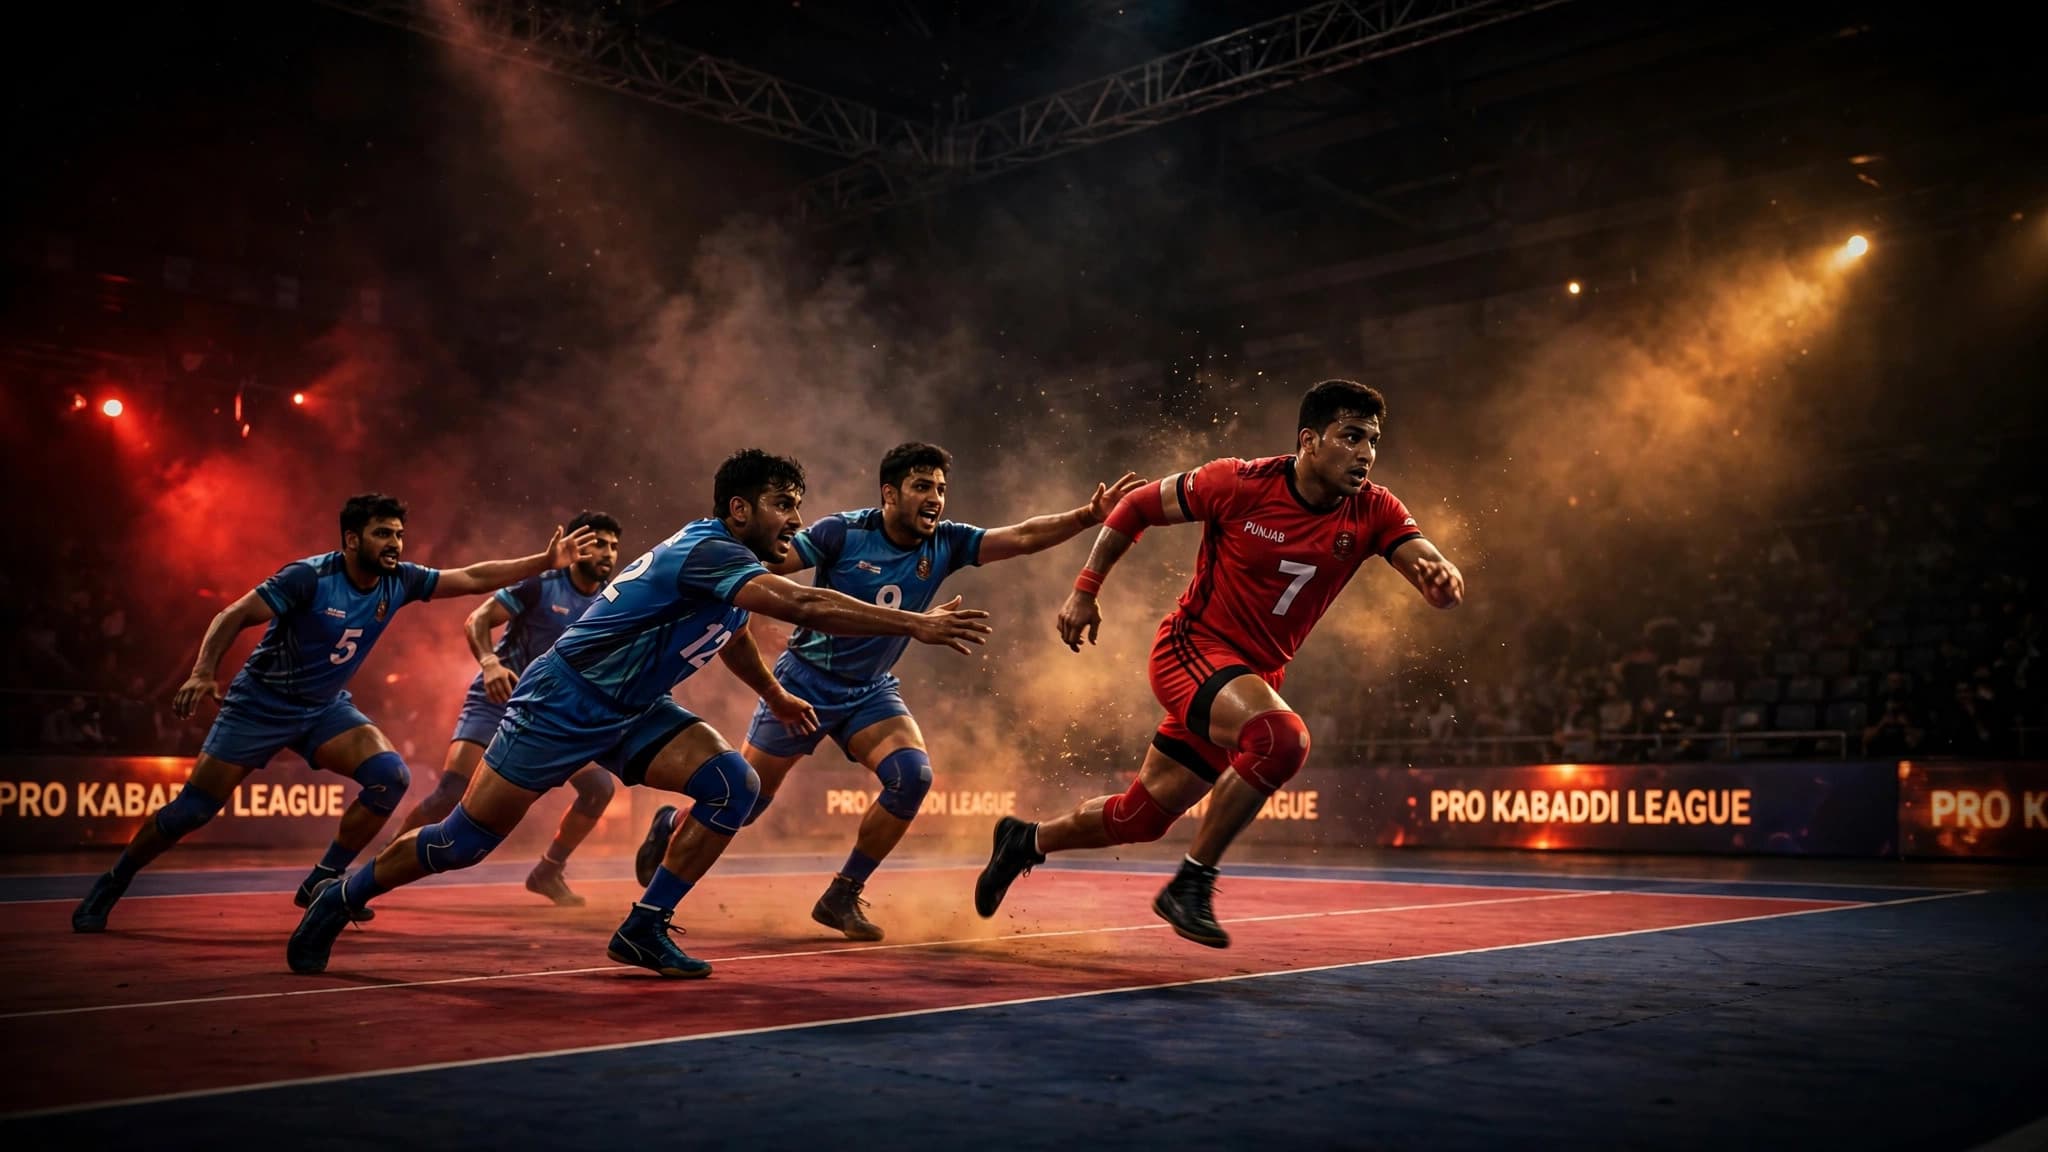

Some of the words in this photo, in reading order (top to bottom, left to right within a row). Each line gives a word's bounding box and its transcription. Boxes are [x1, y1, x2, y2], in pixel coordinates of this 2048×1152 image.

[1243, 520, 1286, 543] PUNJAB
[1272, 559, 1317, 616] 7
[329, 628, 364, 665] 5
[679, 623, 733, 669] 12
[0, 781, 67, 817] PRO
[77, 781, 225, 817] KABA
[233, 784, 345, 817] LEAGUE
[826, 789, 868, 816] PRO
[950, 791, 1017, 816] LEAGUE
[1430, 789, 1486, 822] PRO
[1492, 789, 1619, 823] KABADDI
[1627, 789, 1752, 825] LEAGUE
[1931, 789, 2011, 829] PRO
